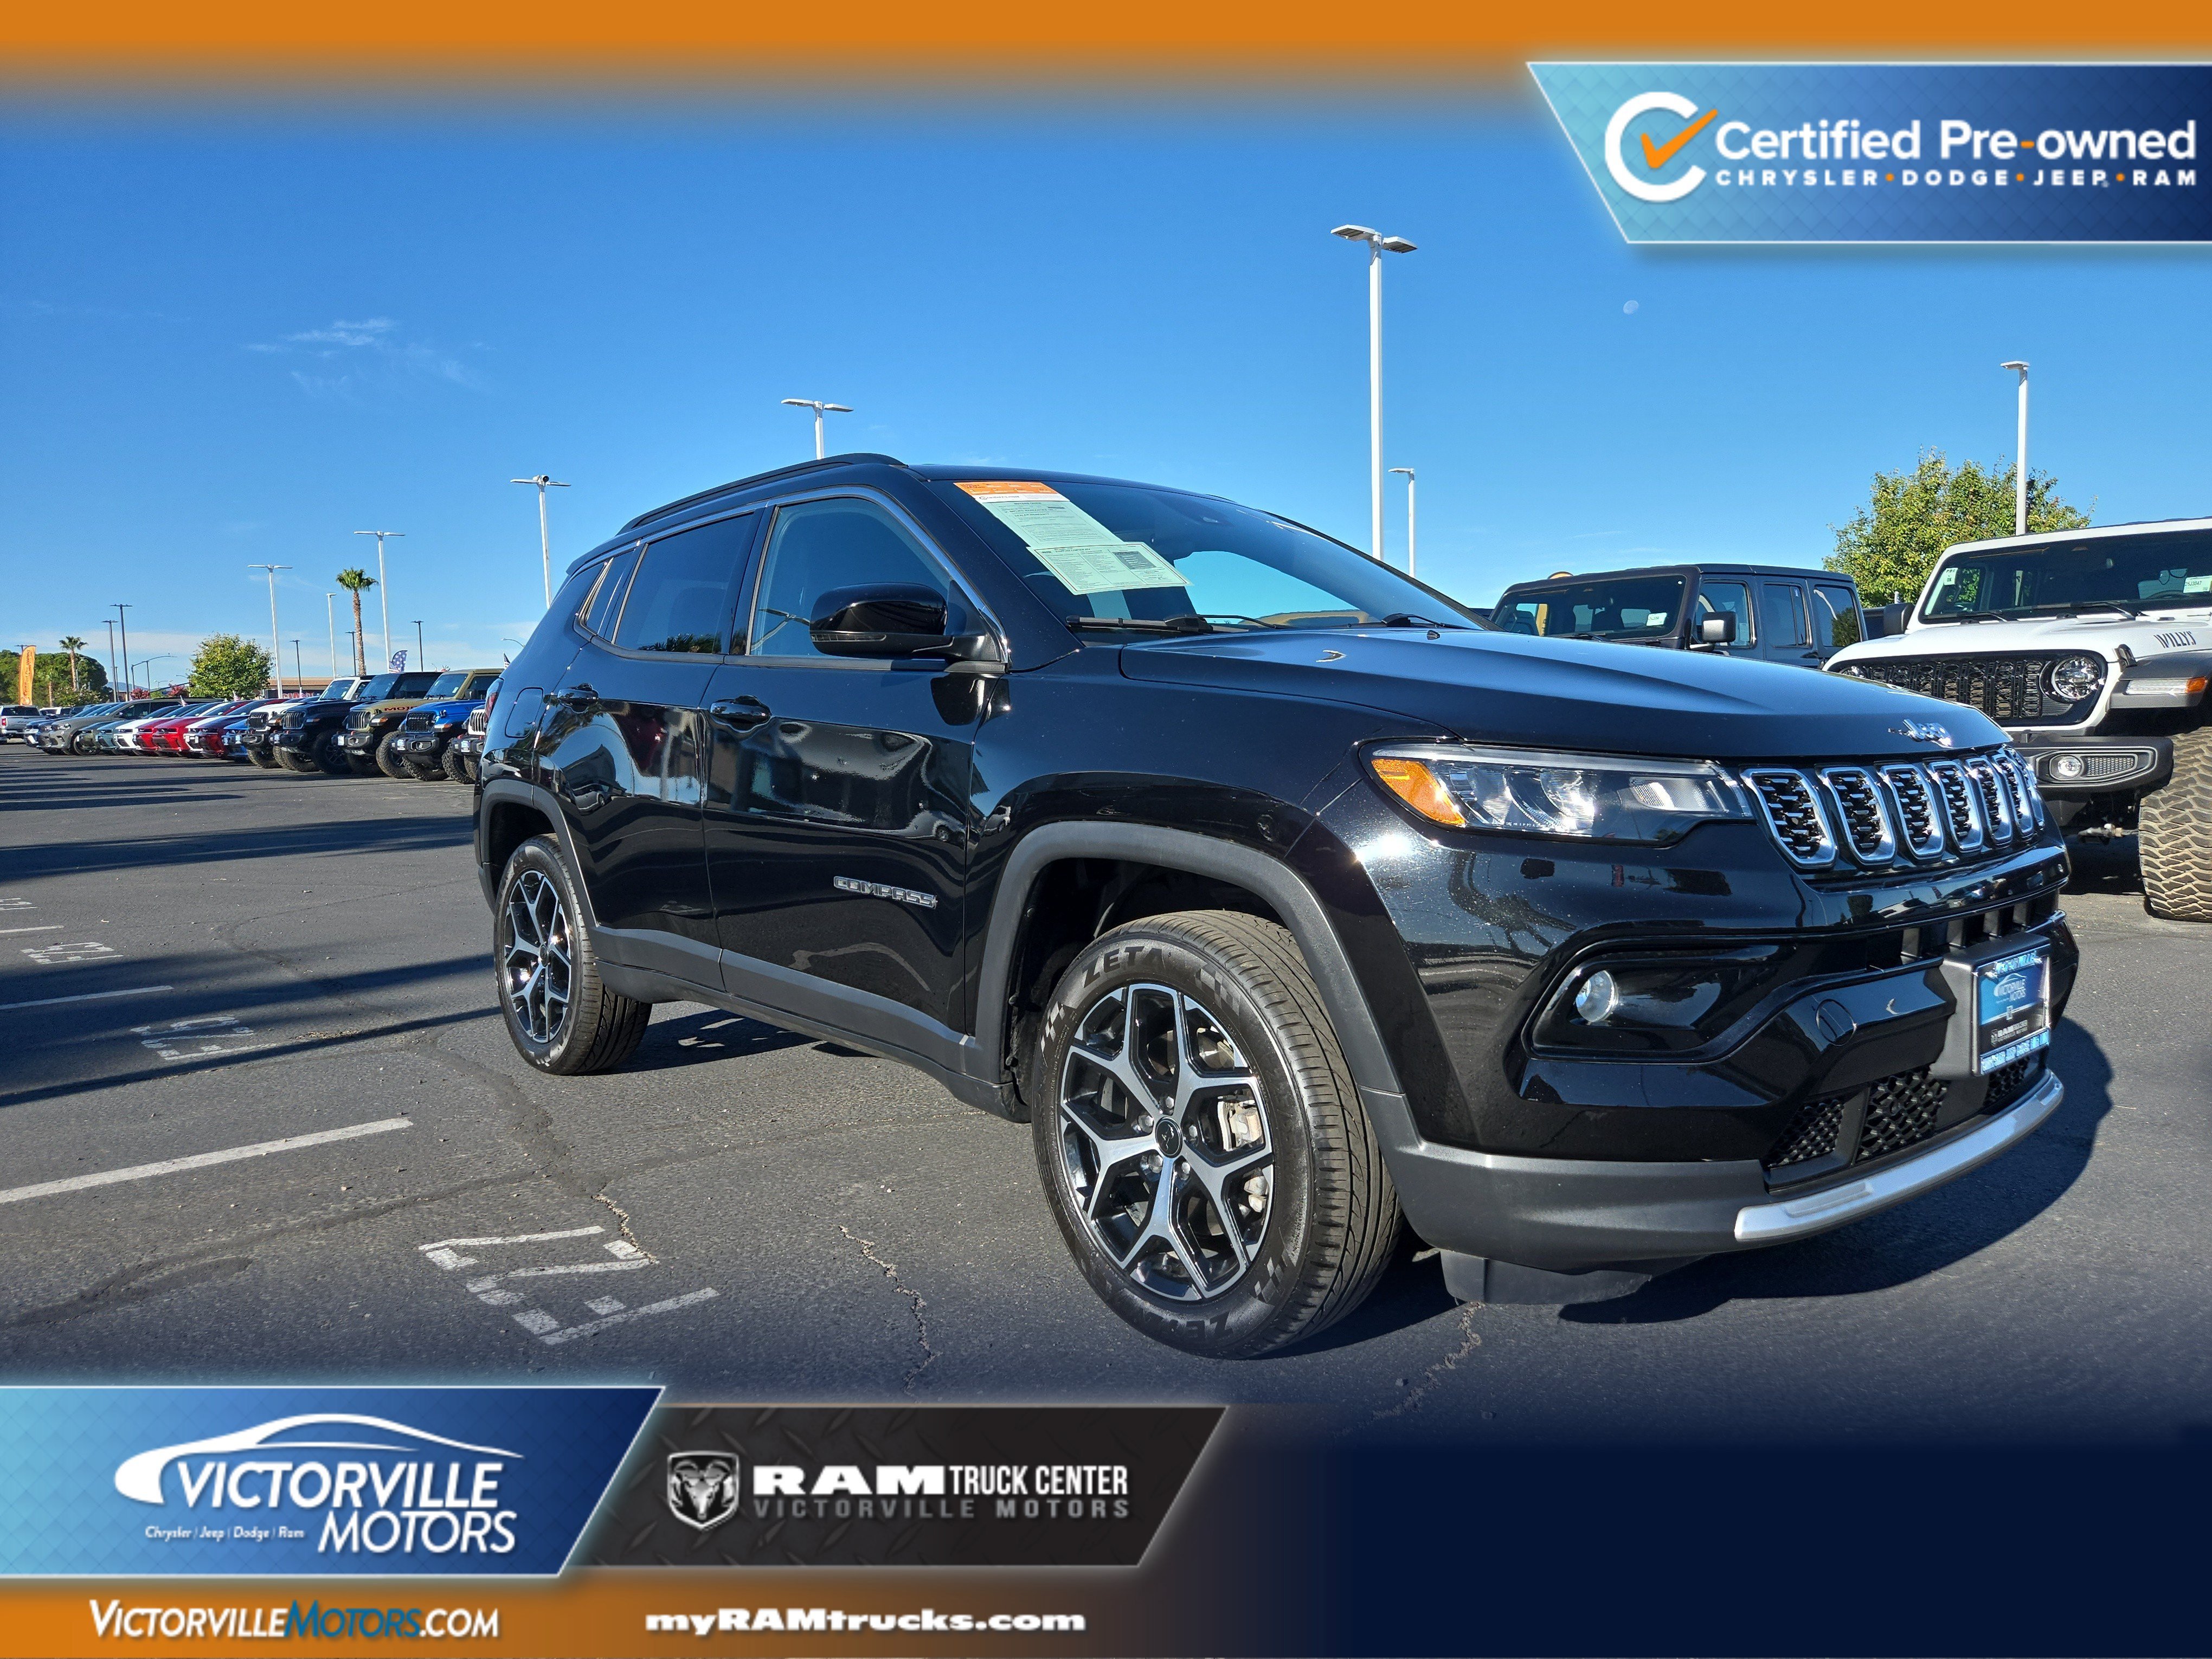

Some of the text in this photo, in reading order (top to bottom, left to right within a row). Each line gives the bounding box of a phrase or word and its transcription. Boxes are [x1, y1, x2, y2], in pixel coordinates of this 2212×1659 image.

[2153, 631, 2196, 649] WILLYS
[1902, 719, 1952, 748] Jeep
[834, 876, 938, 909] COMPASS
[1082, 946, 1166, 988] ZETA
